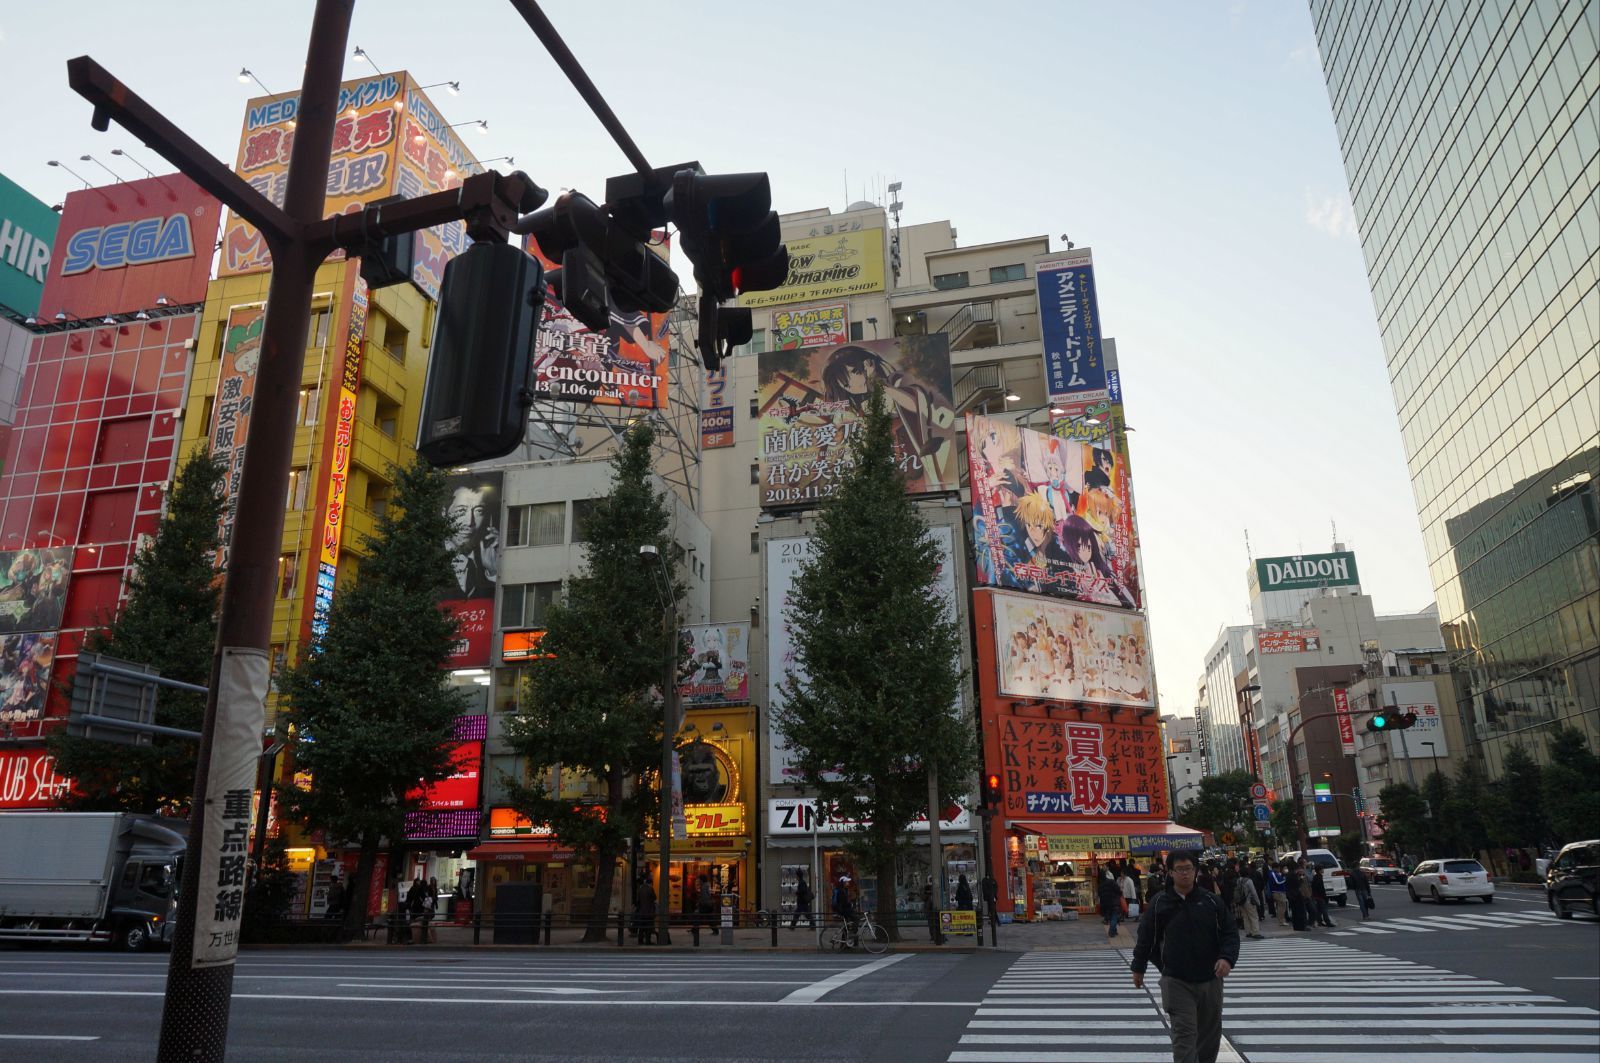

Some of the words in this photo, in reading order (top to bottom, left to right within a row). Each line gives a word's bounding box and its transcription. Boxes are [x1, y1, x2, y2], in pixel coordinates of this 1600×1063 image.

[0, 218, 50, 283] HIR
[62, 214, 194, 275] SEGA
[353, 304, 365, 318] DVD
[350, 333, 360, 344] CD
[604, 388, 625, 399] sale
[708, 434, 724, 445] 3F
[1019, 721, 1038, 788] アイドル
[1034, 722, 1050, 770] アニメ
[1049, 722, 1067, 792] 美少女系
[1065, 721, 1111, 814] 買取
[1106, 727, 1122, 792] フィギュア
[1119, 728, 1132, 774] ホビー
[1131, 728, 1149, 793] 携帯電話
[775, 803, 824, 831] ZIN
[1027, 794, 1070, 811] チケット
[1112, 795, 1150, 813] 大黒屋
[213, 788, 250, 922] 重点路線
